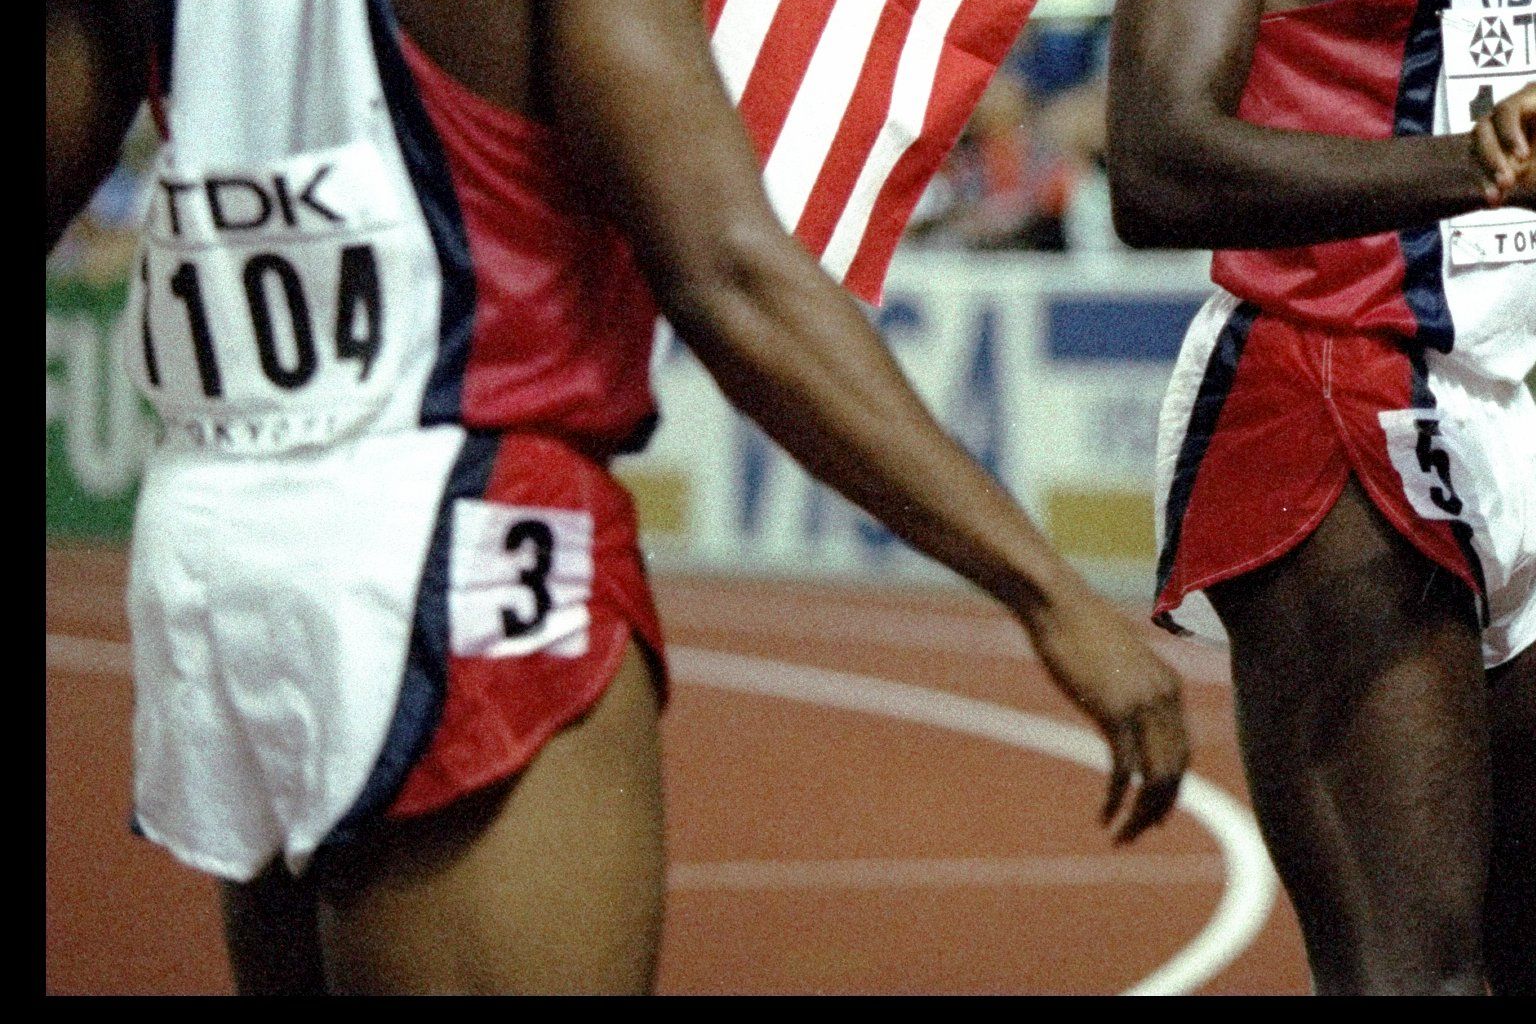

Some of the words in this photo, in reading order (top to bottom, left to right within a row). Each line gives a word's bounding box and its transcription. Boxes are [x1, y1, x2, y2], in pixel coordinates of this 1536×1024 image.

[158, 165, 345, 236] TDK
[1414, 419, 1463, 516] 5
[501, 519, 554, 638] 3
